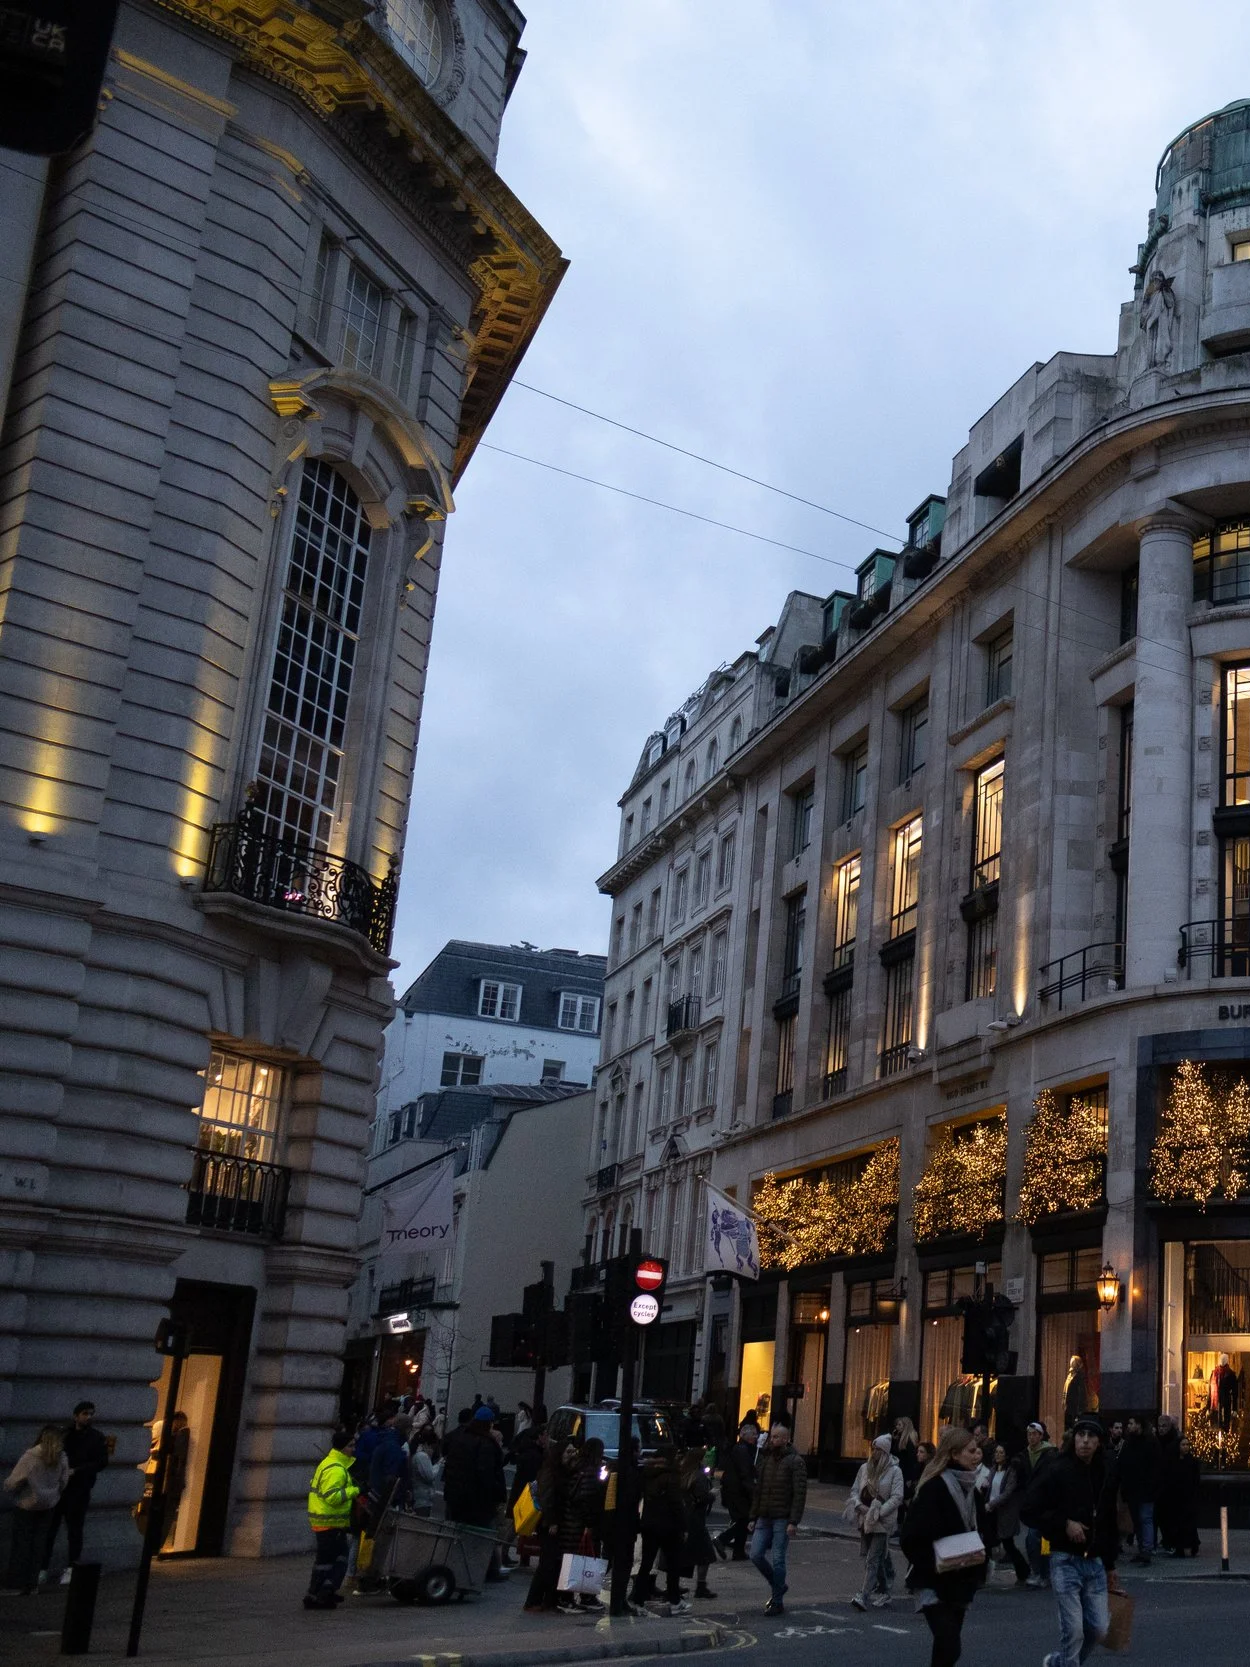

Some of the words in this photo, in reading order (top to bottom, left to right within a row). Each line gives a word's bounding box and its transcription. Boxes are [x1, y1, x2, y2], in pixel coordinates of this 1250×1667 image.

[386, 1224, 449, 1243] Theory
[633, 1302, 656, 1311] Except
[633, 1311, 654, 1319] cycles
